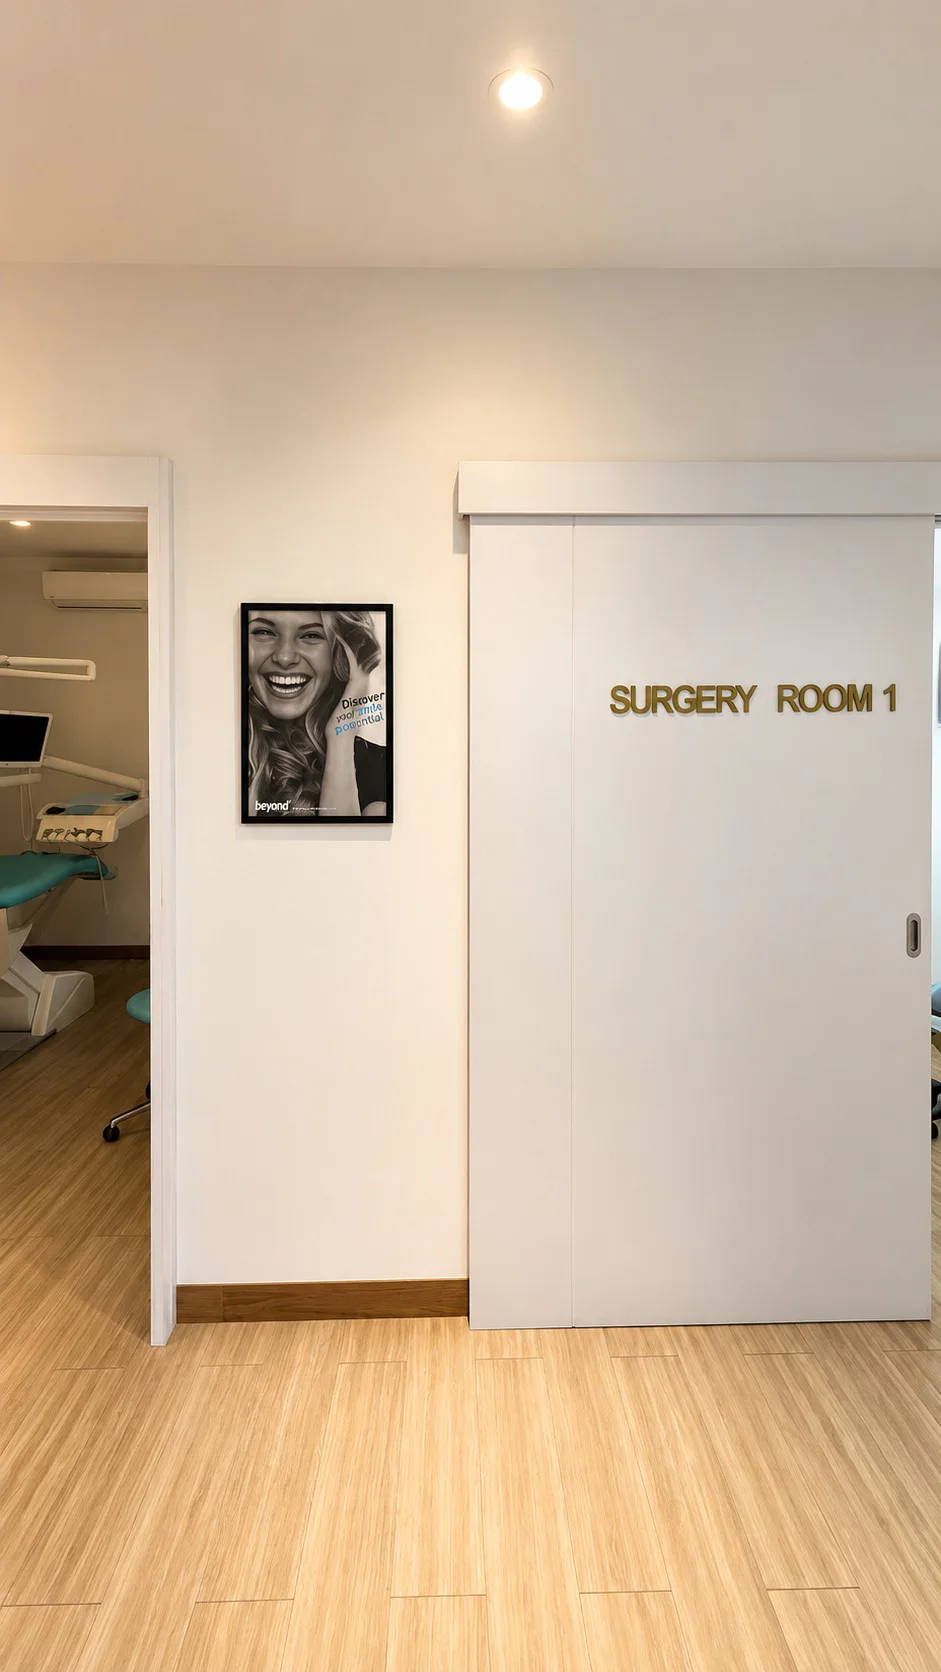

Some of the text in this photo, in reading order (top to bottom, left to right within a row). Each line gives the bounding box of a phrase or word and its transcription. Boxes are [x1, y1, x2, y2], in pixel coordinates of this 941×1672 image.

[341, 692, 385, 710] Discover
[610, 683, 896, 715] SURGERY ROOM 1
[255, 800, 290, 813] beyond
